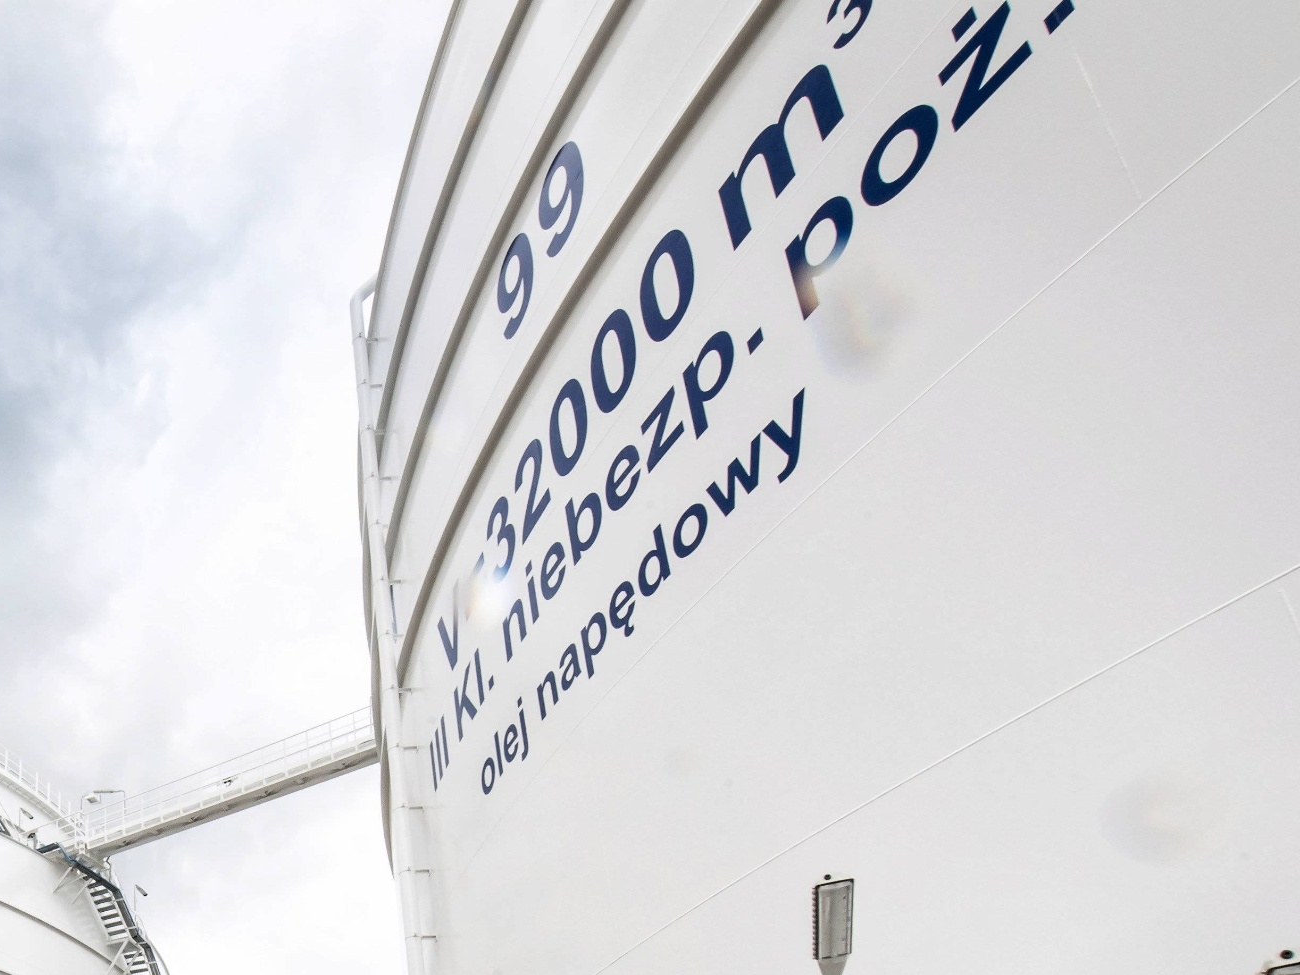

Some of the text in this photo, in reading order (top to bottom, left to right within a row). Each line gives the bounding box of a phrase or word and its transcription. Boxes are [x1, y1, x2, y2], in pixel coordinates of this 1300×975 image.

[429, 714, 450, 792] III
[502, 327, 765, 663] niebezp.
[785, 0, 1077, 320] poż.
[496, 140, 585, 341] 99
[480, 386, 806, 796] olej napędowy
